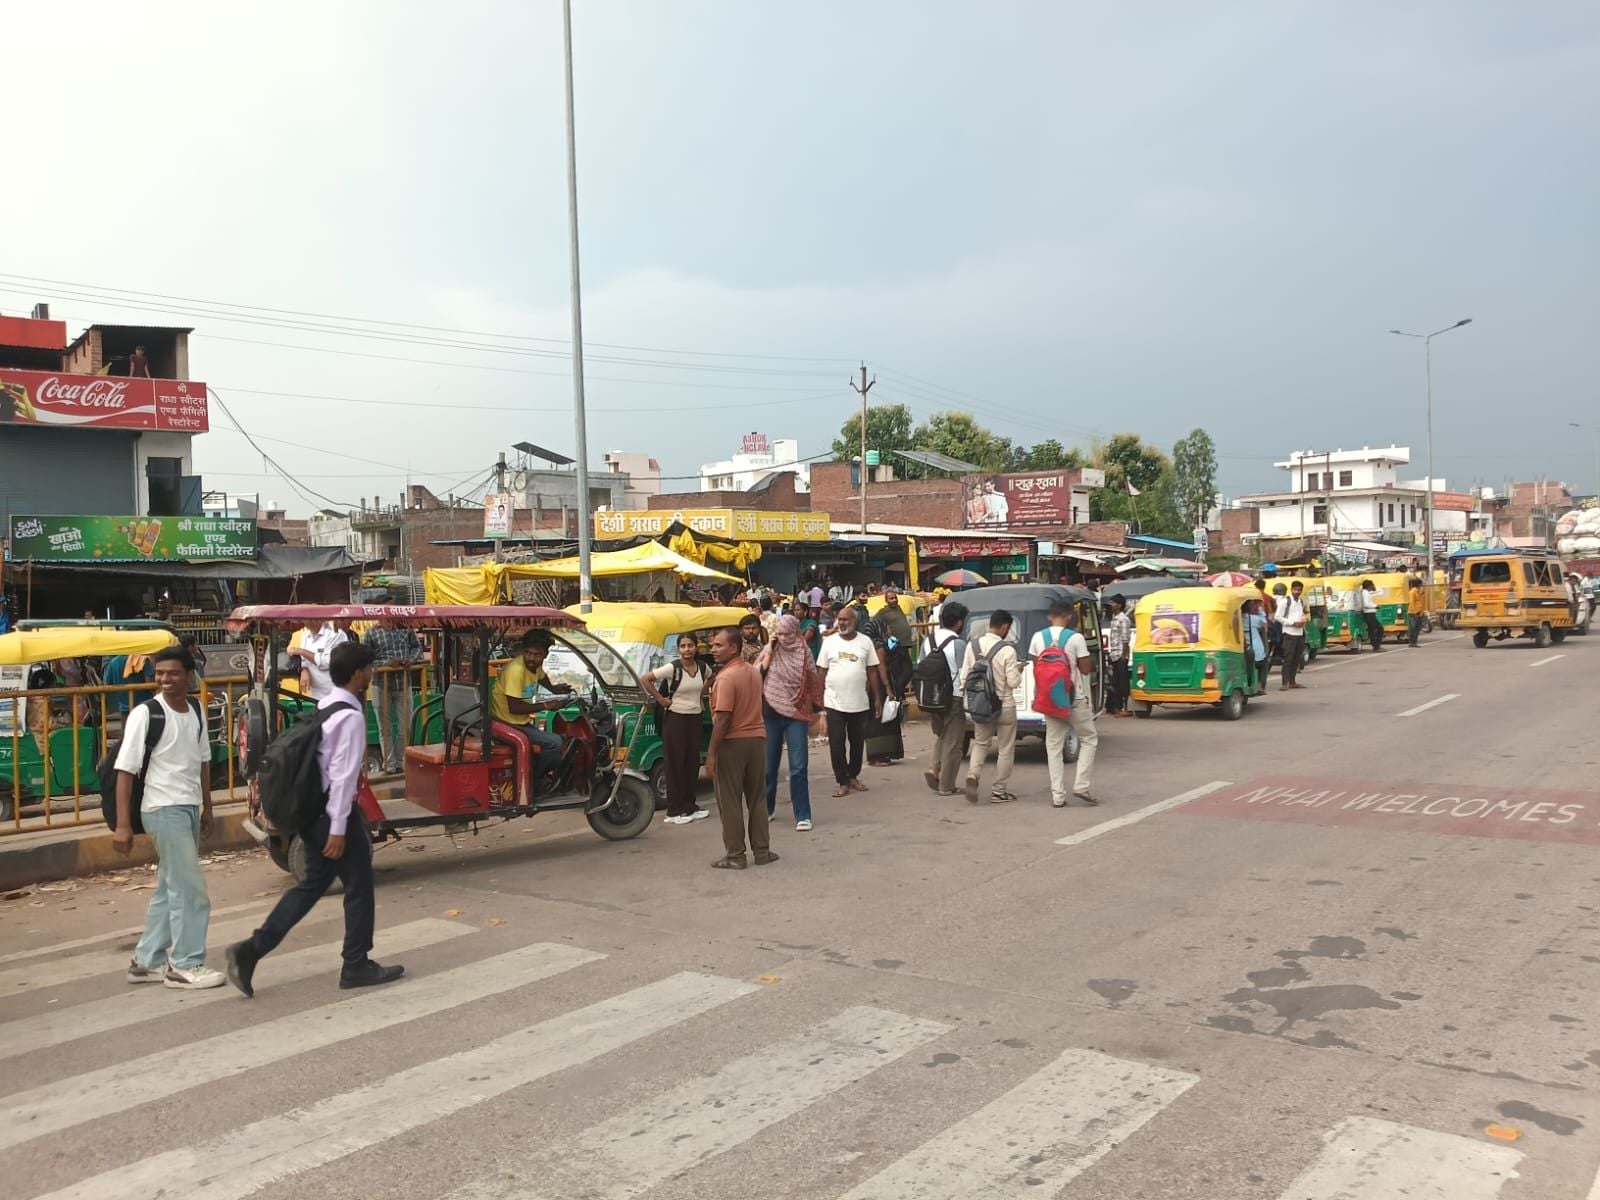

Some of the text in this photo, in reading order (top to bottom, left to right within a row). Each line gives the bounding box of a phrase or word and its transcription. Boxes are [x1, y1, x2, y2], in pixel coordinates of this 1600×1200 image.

[177, 382, 187, 393] श्री
[159, 395, 177, 404] राधा
[177, 518, 252, 535] श्री राधा स्वीट्स
[599, 512, 625, 533] देशी
[629, 516, 662, 532] शराब
[688, 515, 728, 532] दकान
[736, 512, 827, 538] देशी शराब की दुकान
[204, 533, 227, 543] एण्ड
[176, 542, 254, 556] फैमिली रेस्टोरेन्ट
[1232, 786, 1585, 824] NHAI WELCOMES
